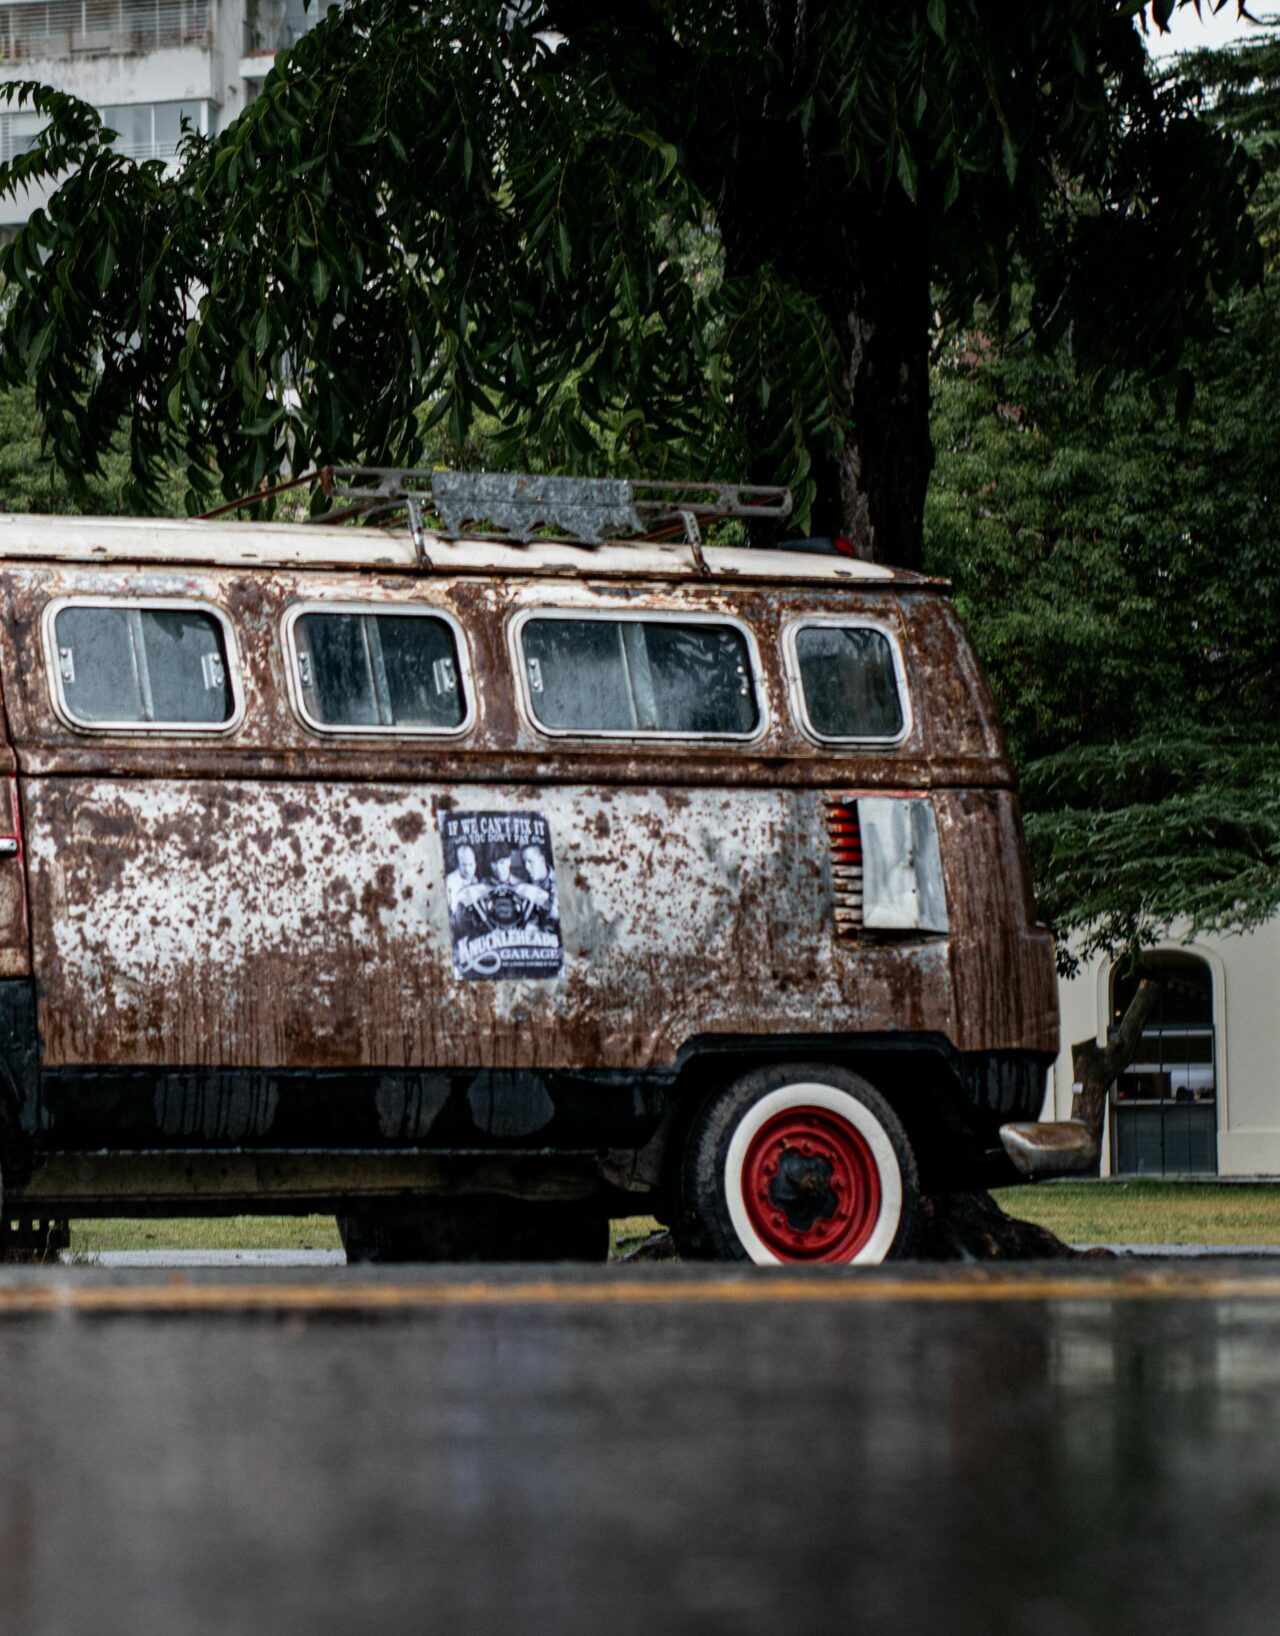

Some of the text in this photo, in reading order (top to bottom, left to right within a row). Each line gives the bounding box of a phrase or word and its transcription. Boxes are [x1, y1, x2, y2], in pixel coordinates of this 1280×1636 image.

[448, 816, 545, 836] IF WE CAN'T FIX IT
[469, 832, 530, 845] YOU DON'T PAY
[457, 928, 559, 963] KNUCKLEHEADS
[500, 948, 560, 961] GARAGE
